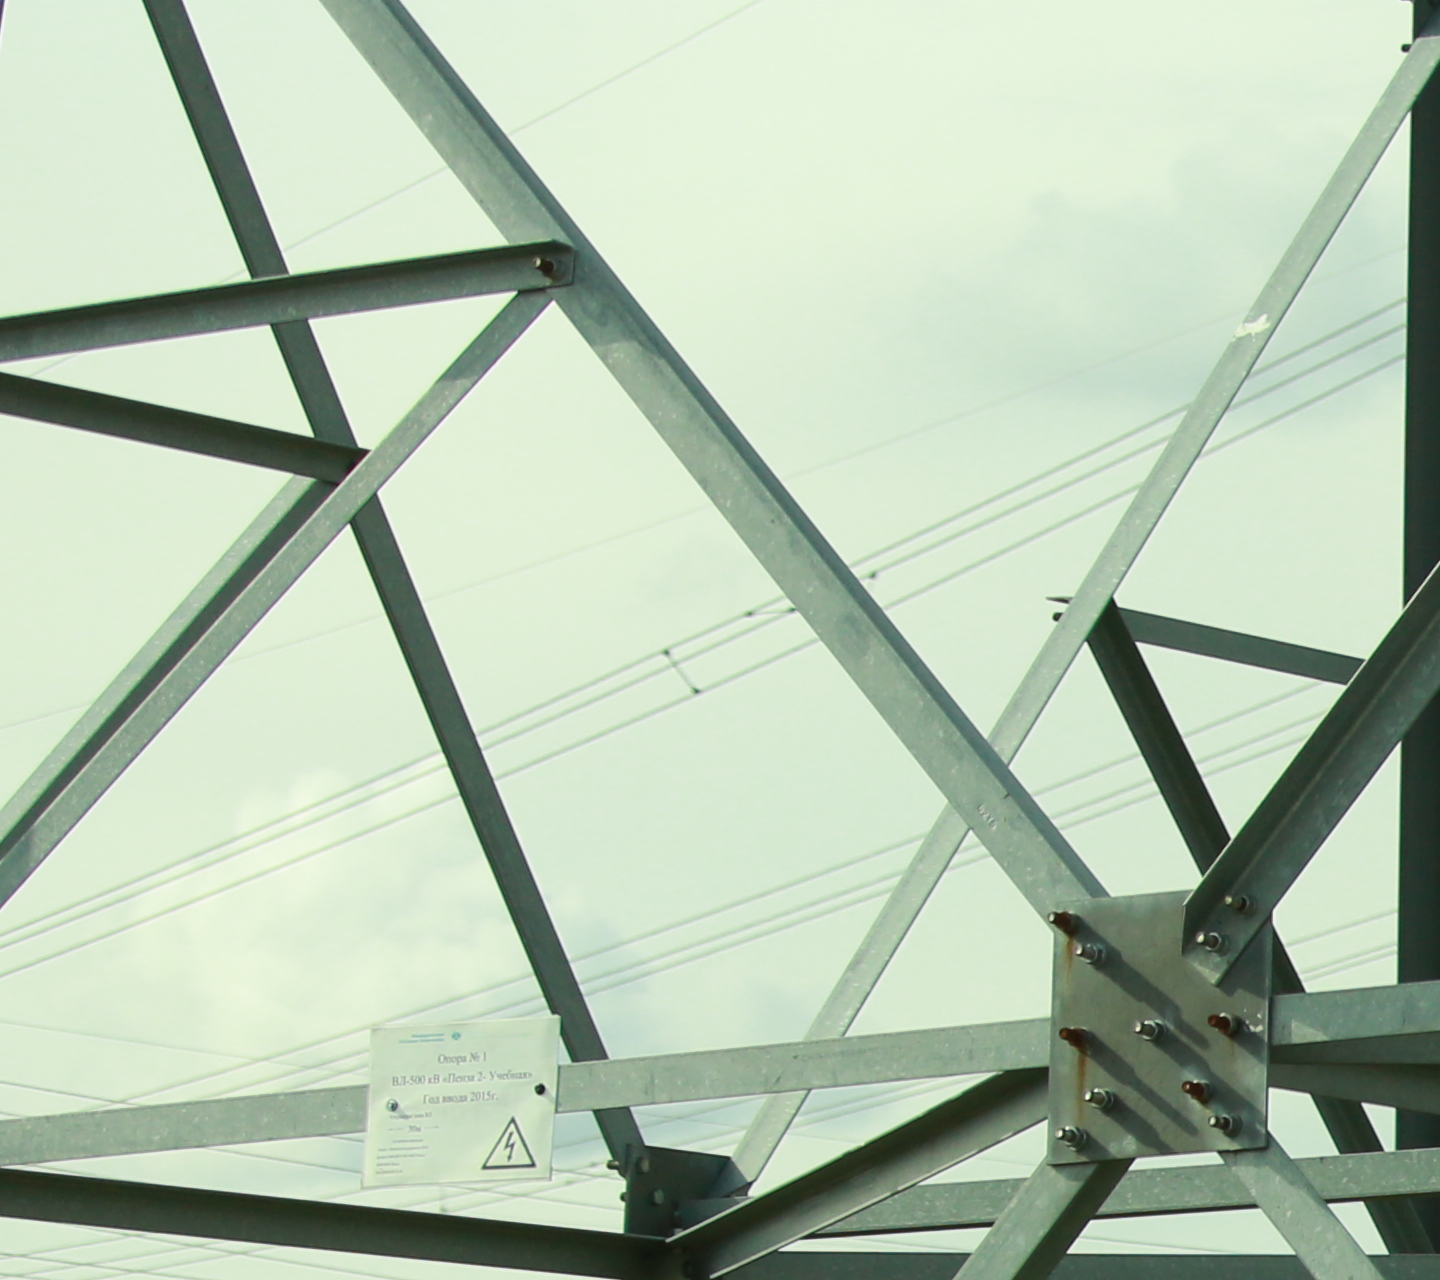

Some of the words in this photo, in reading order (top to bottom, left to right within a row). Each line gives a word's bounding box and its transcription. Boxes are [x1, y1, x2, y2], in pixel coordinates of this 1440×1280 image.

[438, 1053, 467, 1066] Опора
[469, 1052, 480, 1062] №
[392, 1075, 425, 1086] ВЛ-500
[428, 1074, 440, 1084] кВ
[422, 1095, 440, 1105] Год
[441, 1094, 468, 1104] ввода
[470, 1090, 499, 1102] 2015г.
